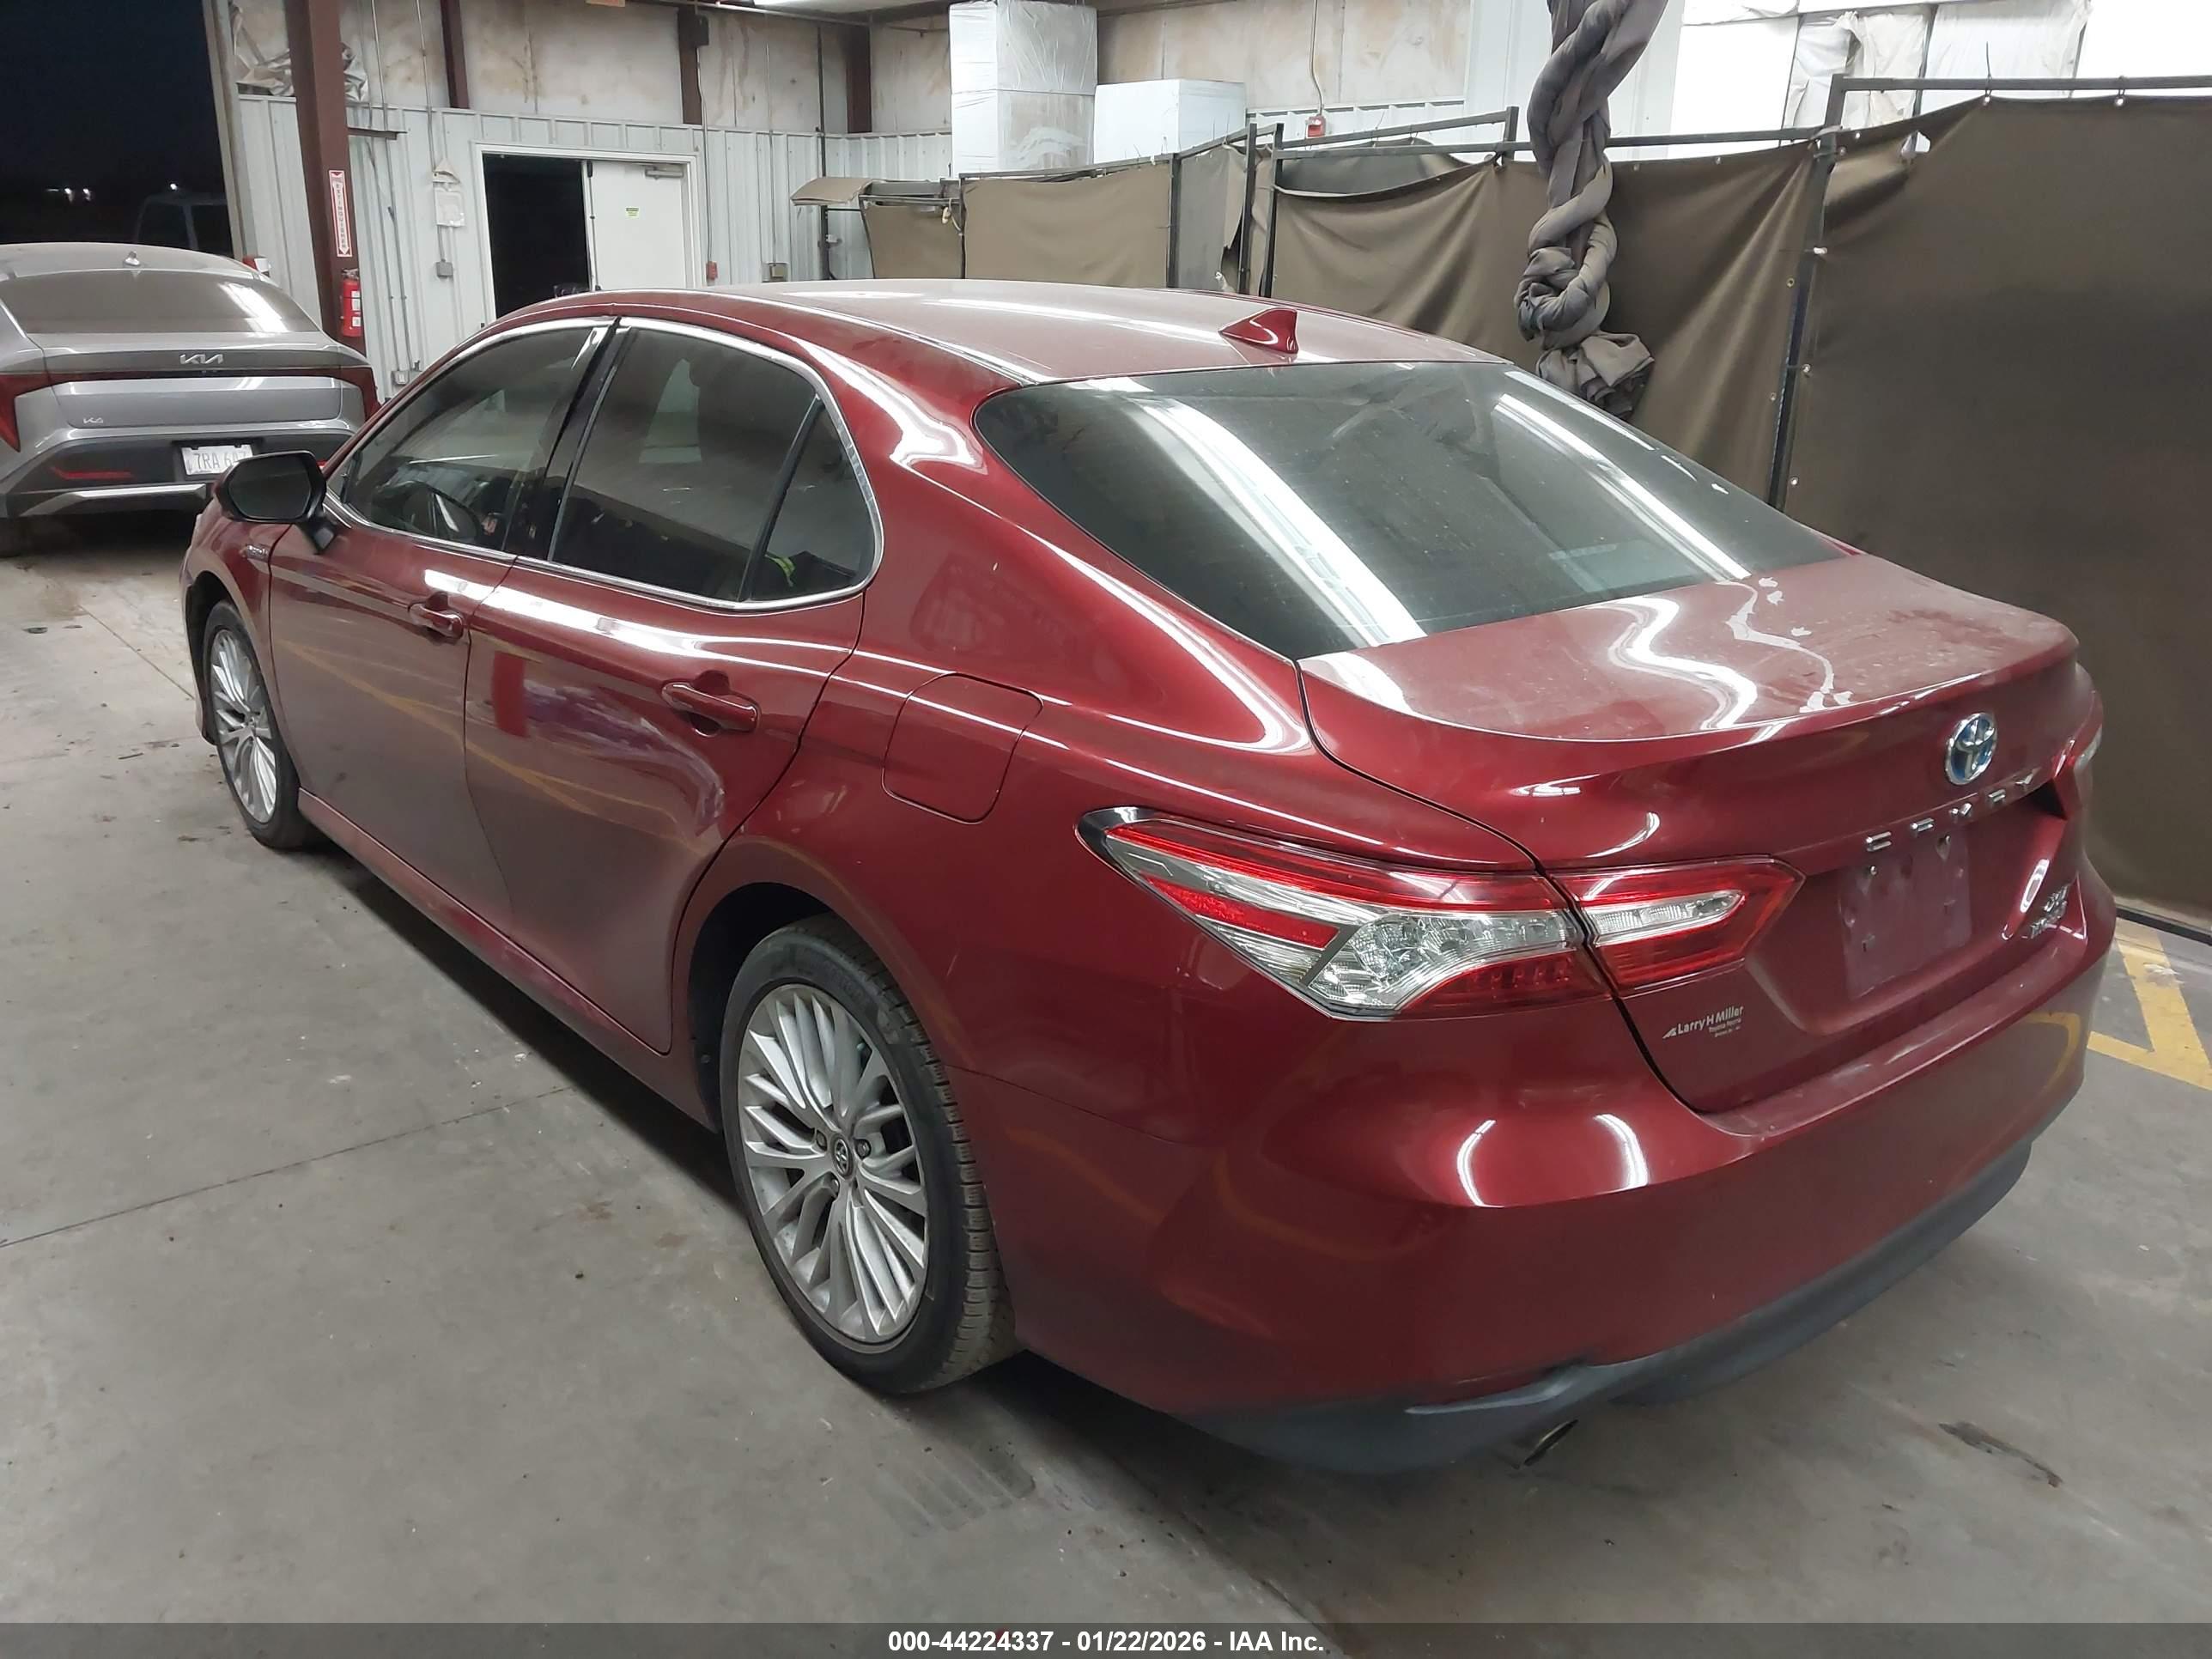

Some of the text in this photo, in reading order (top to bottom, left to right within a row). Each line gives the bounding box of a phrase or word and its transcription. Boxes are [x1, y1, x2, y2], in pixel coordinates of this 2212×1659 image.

[193, 453, 221, 471] 7RA
[1677, 1018, 1705, 1035] Larry
[1705, 1014, 1715, 1026] H
[1715, 1006, 1744, 1024] Miller
